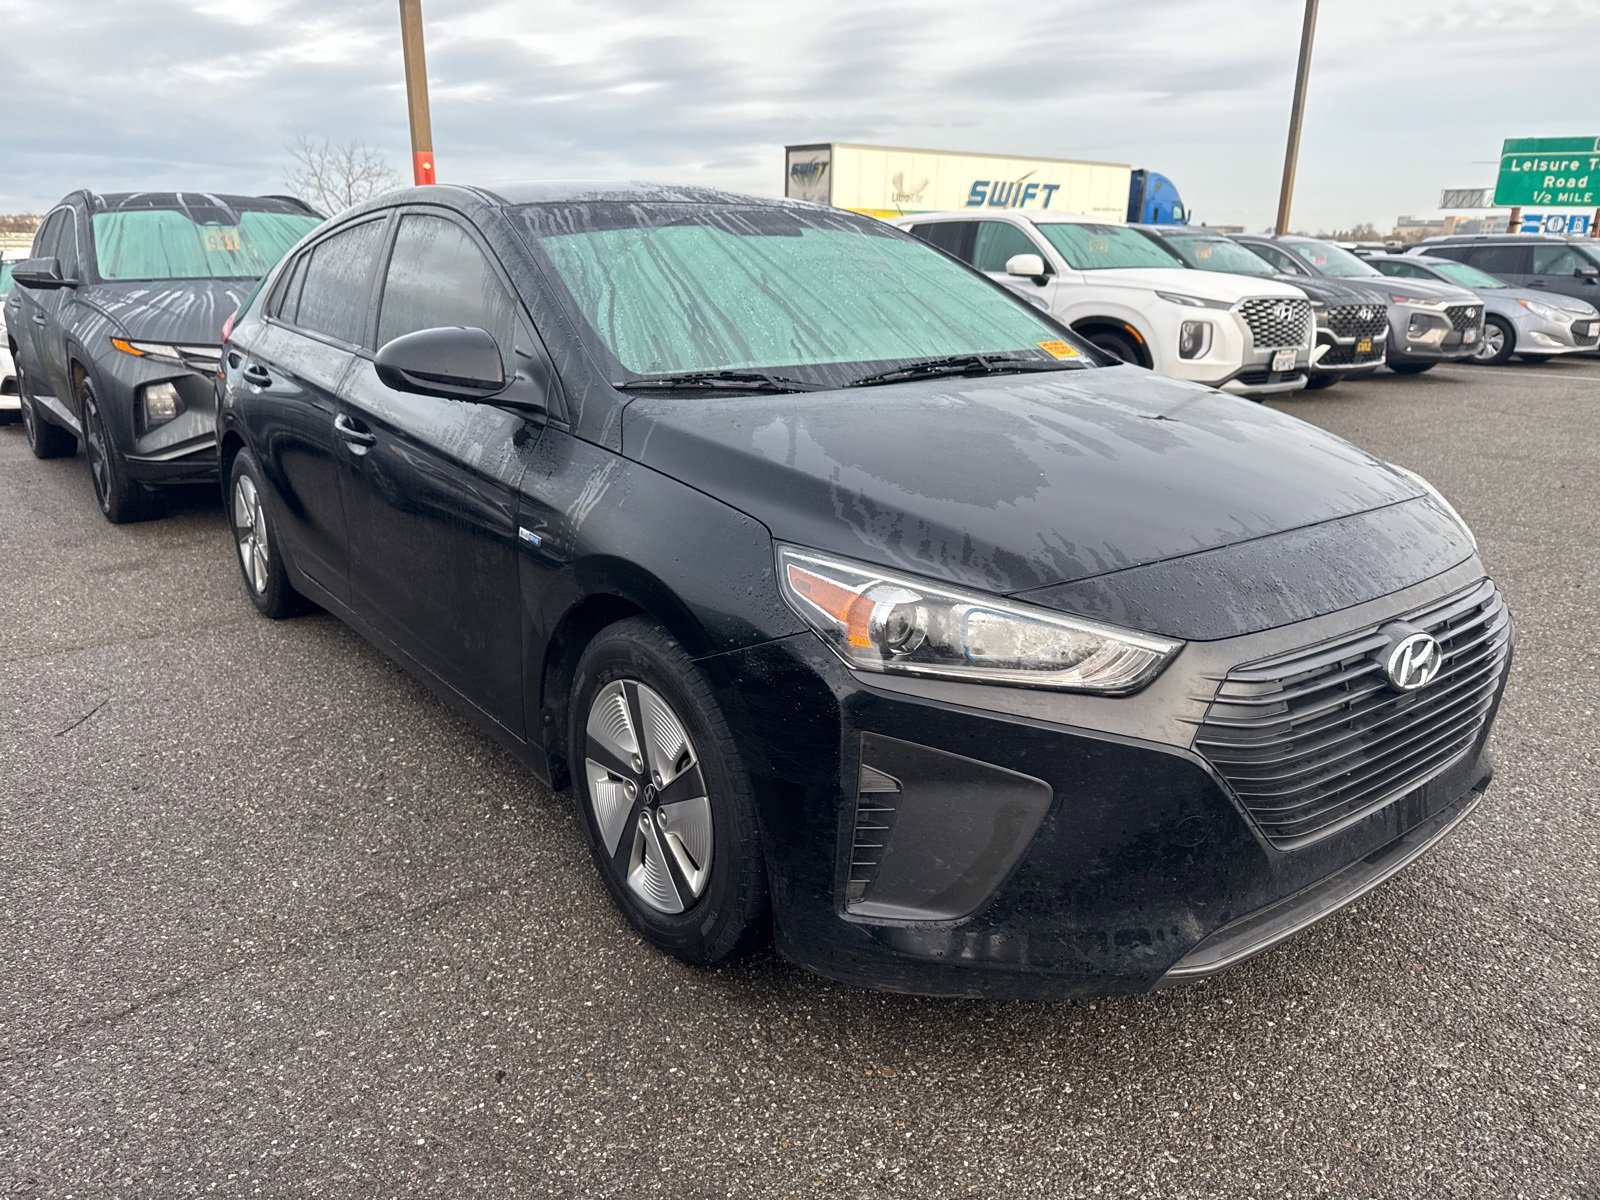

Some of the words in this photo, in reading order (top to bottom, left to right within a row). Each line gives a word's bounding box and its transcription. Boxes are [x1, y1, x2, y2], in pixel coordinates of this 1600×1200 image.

[791, 161, 829, 177] SWIFT
[1511, 158, 1580, 172] Leisure
[1588, 157, 1600, 171] T
[1543, 175, 1589, 189] Road
[966, 180, 1061, 209] SWIFT
[1533, 190, 1552, 204] 1/2
[1557, 192, 1594, 203] MILE
